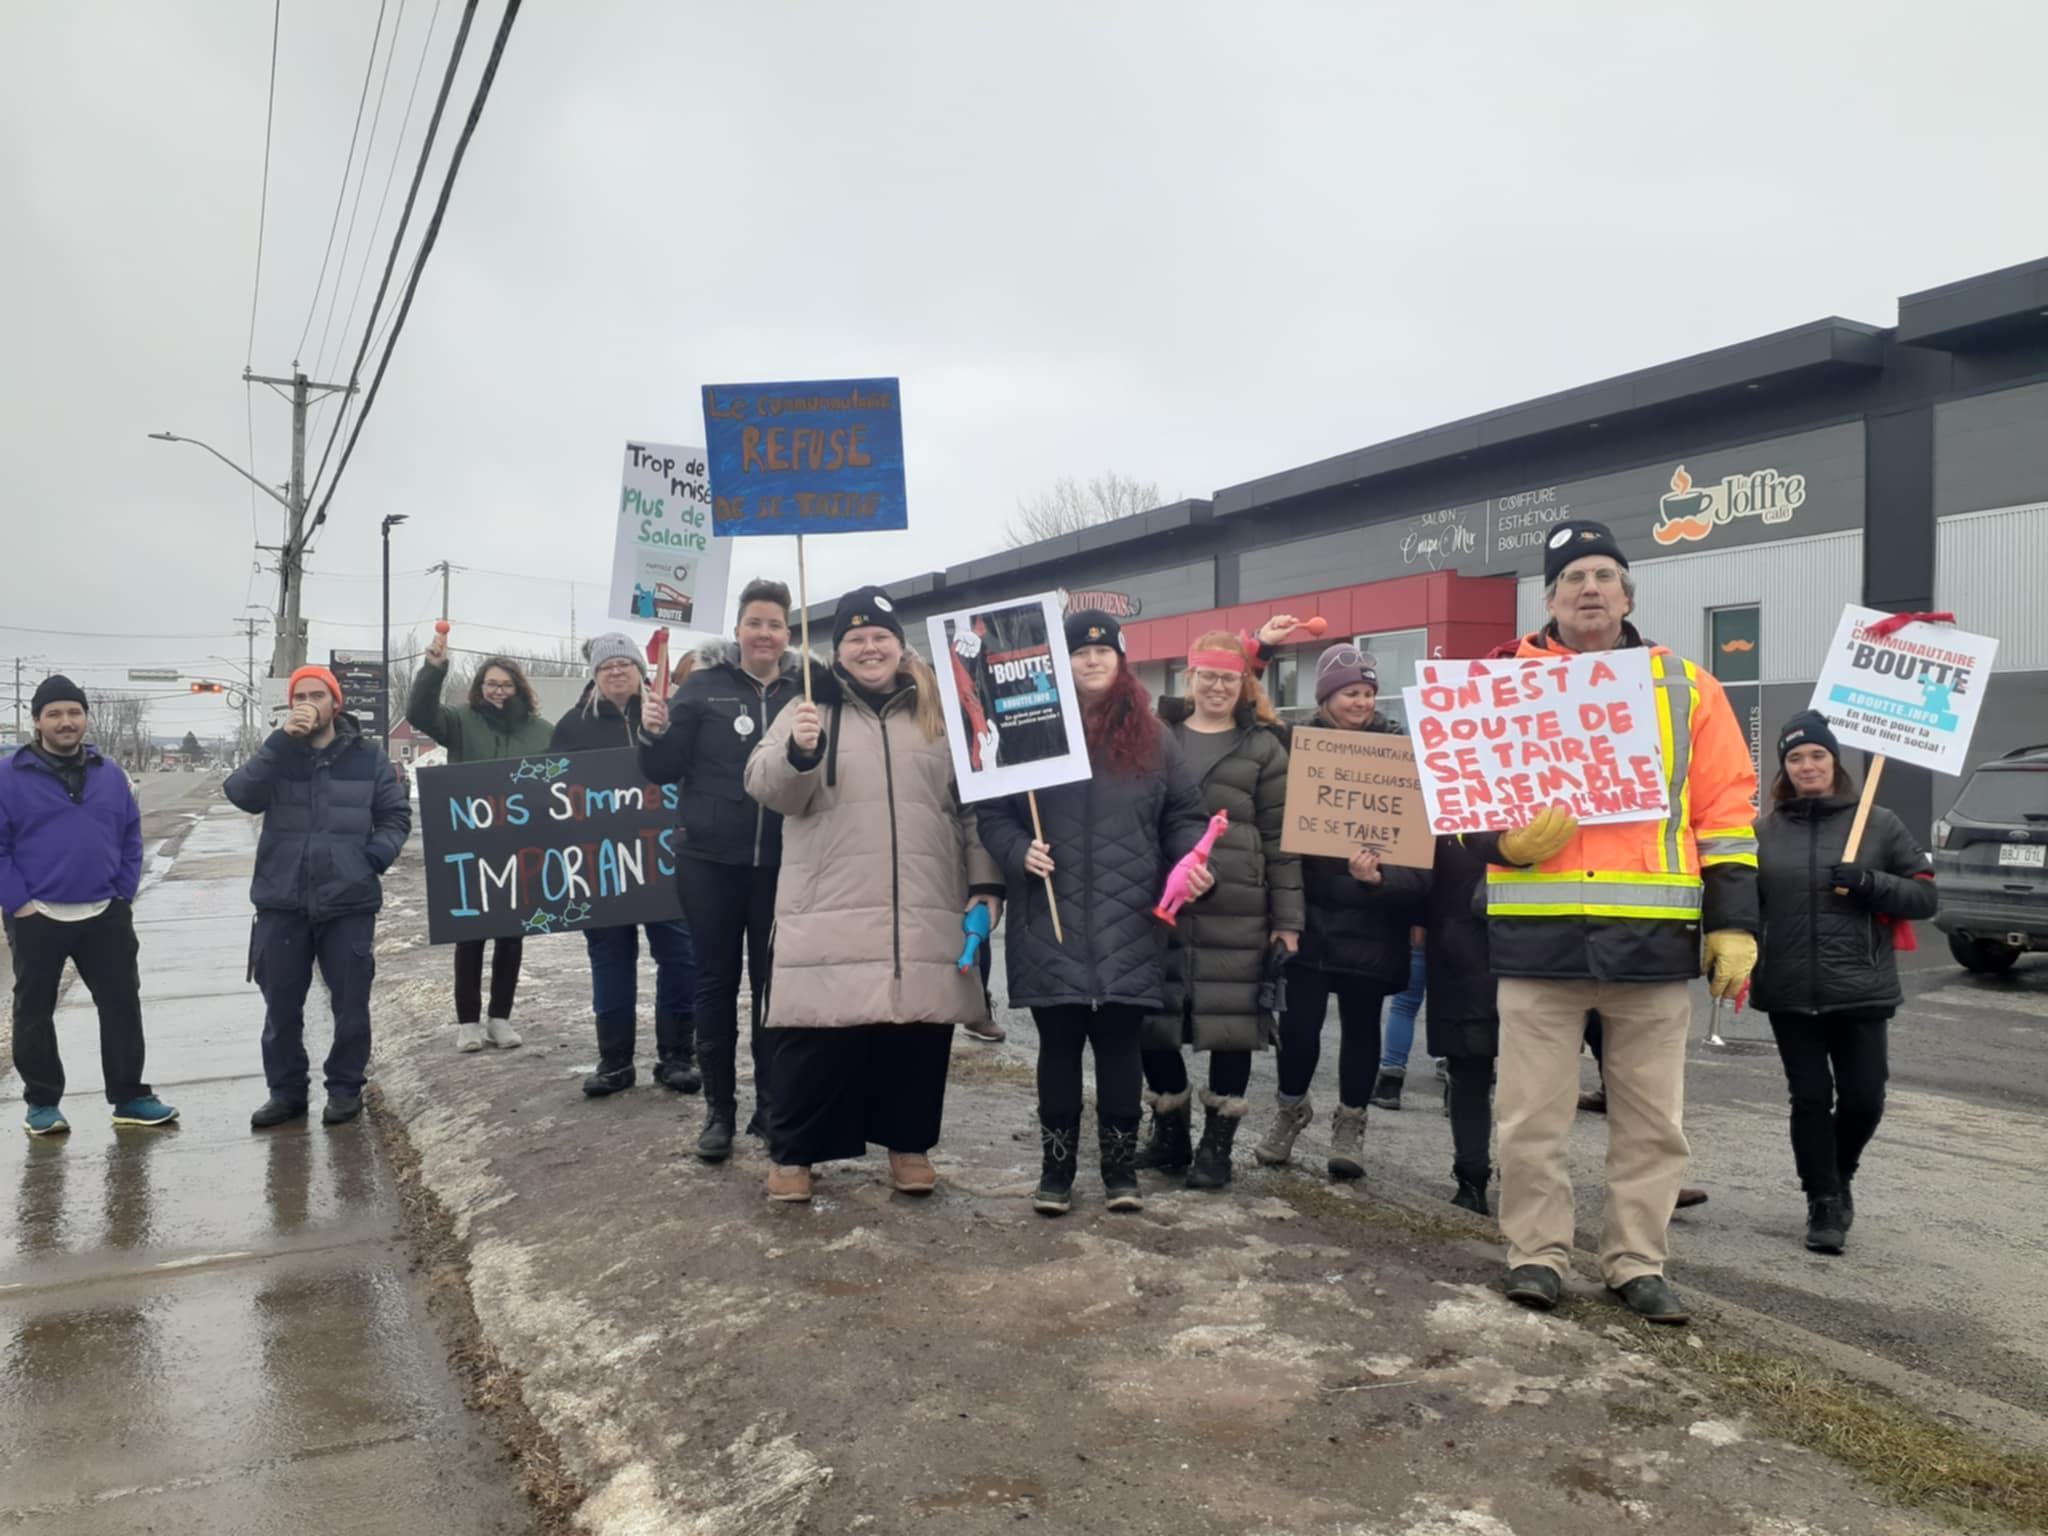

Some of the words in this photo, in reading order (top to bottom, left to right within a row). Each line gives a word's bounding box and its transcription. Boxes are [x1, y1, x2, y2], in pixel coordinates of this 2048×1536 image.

[626, 443, 675, 479] Trop
[685, 458, 705, 477] de
[742, 424, 872, 474] REFUSE
[622, 486, 664, 518] Plus
[681, 505, 705, 528] de
[714, 495, 745, 521] DE
[1499, 486, 1557, 511] COIFFURE
[1714, 471, 1804, 522] Joffre
[1421, 508, 1457, 527] SALON
[1498, 504, 1570, 531] ESTHÉTIQUE
[1498, 529, 1549, 551] BOUTIQ
[994, 654, 1054, 685] BOUTTE
[1851, 643, 1972, 695] BOUTTE
[1421, 680, 1482, 713] ON
[1491, 666, 1570, 709] EST
[1419, 710, 1562, 750] BOUTE
[1578, 701, 1633, 734] DE
[1846, 708, 1860, 720] En
[1862, 712, 1888, 727] lutte
[1889, 719, 1916, 735] pour
[1918, 725, 1931, 738] la
[1861, 724, 1877, 736] du
[1903, 734, 1939, 753] social
[1294, 736, 1311, 751] LE
[1424, 747, 1485, 783] SE
[1491, 735, 1617, 768] TAIRE
[1307, 766, 1325, 778] DE
[1436, 755, 1659, 816] ENSEMBLE
[449, 793, 530, 831] NOUS
[1317, 785, 1403, 816] REFUSE
[1298, 815, 1318, 833] DE
[1324, 819, 1340, 835] SE
[1433, 811, 1481, 833] ON
[444, 828, 676, 917] IMPORTANTS
